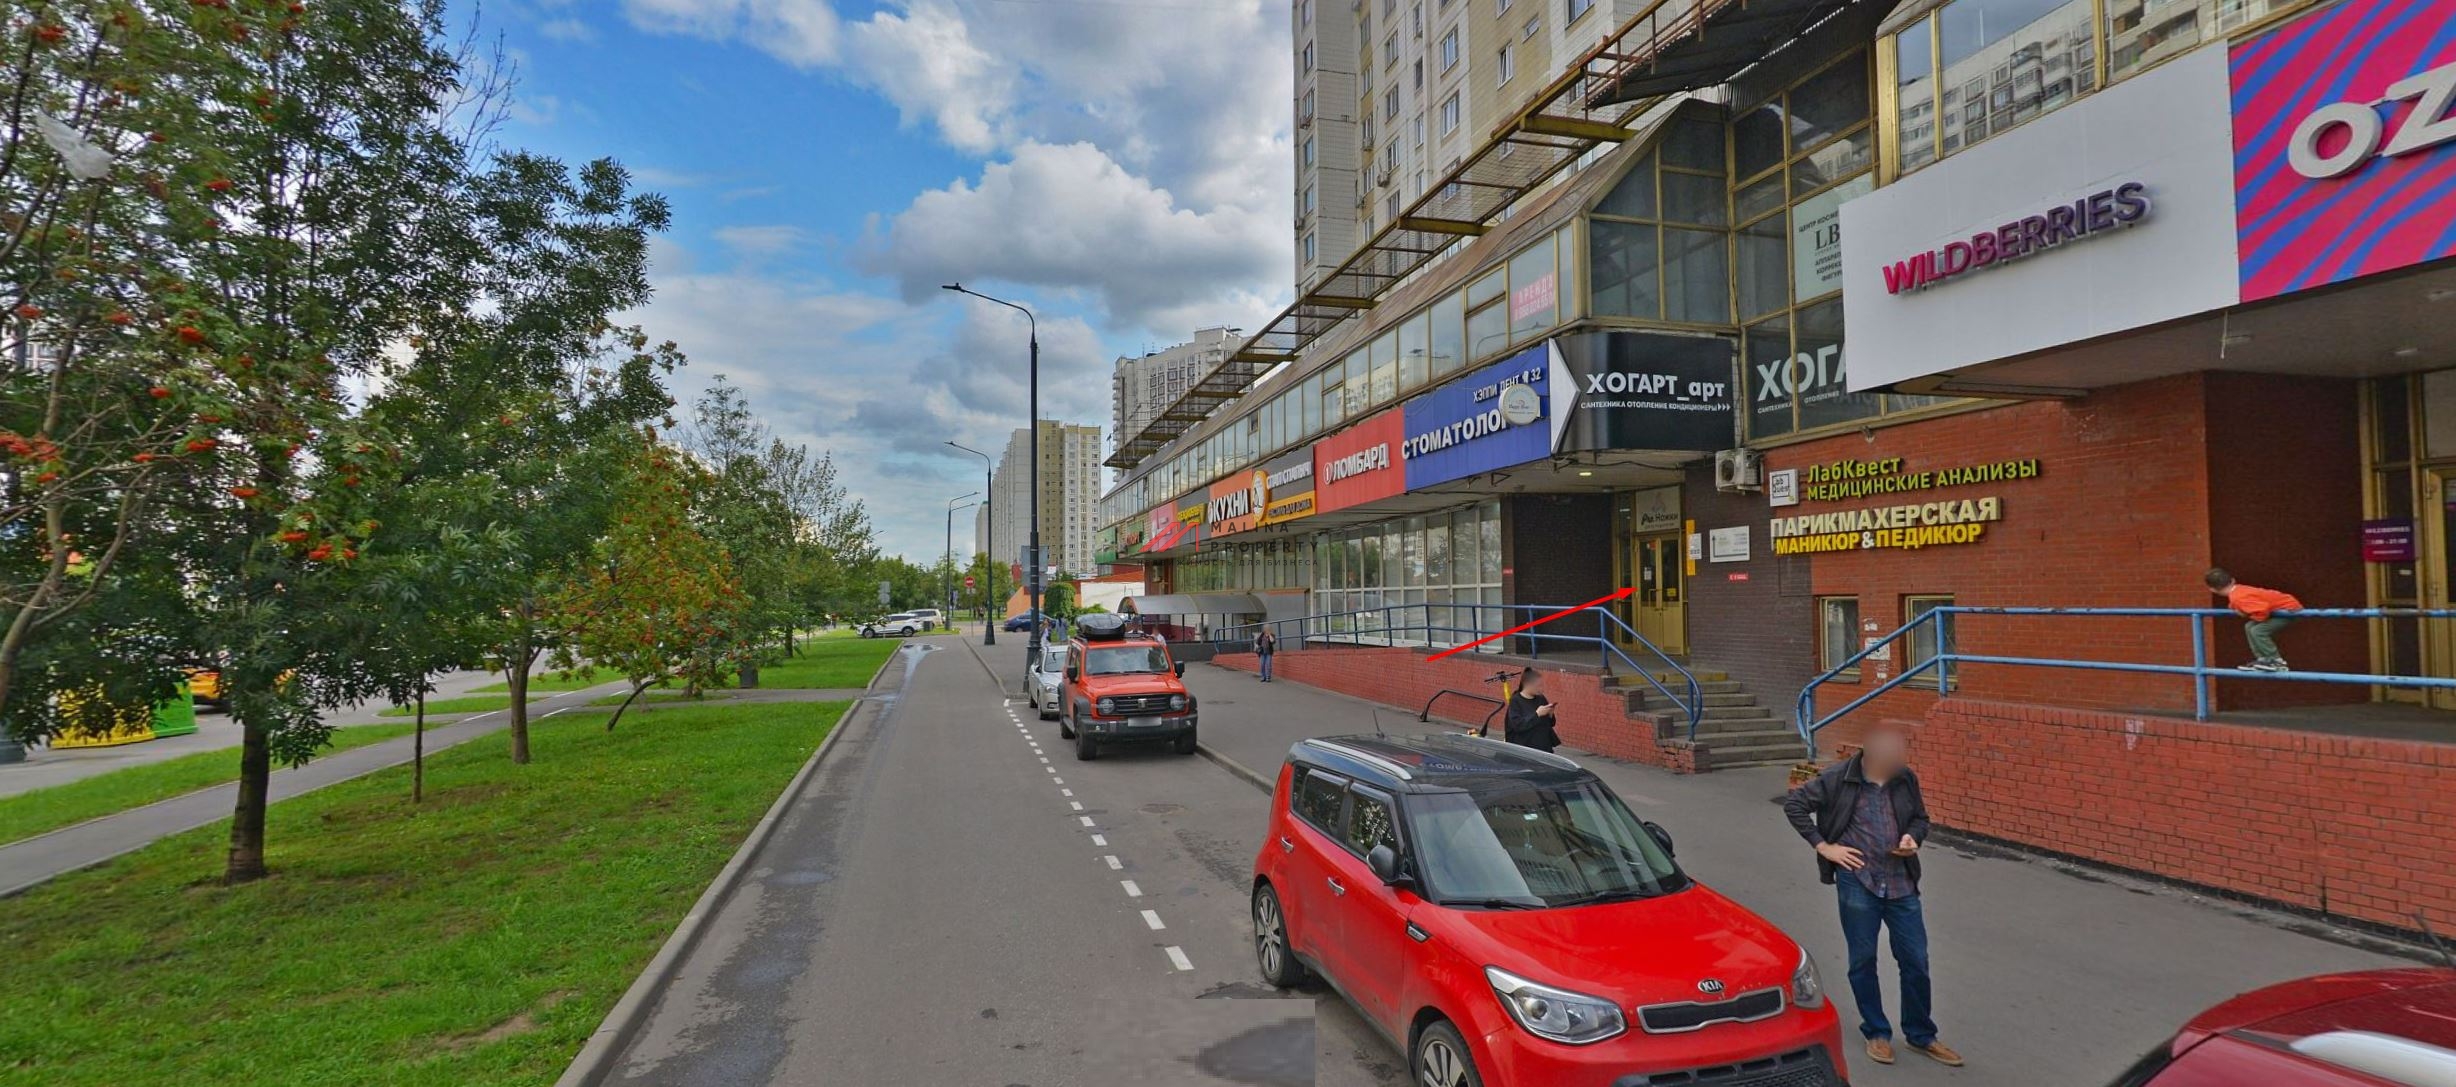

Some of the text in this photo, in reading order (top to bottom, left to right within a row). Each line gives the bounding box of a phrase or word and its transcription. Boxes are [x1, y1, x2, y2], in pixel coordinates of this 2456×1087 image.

[1799, 220, 1816, 233] ЦЕНТР
[1882, 181, 2147, 295] WILDBERRIES
[1473, 384, 1498, 403] ХЭППИ
[1531, 367, 1541, 381] 32
[1586, 372, 1725, 402] ХОГАРТ_арт
[1804, 390, 1840, 404] ОТОПЛЕНИЕ
[1581, 401, 1717, 412] САНТЕХНИКА ОТОПЛЕНИЕ КОНДИЦИОНЕРЫ
[1333, 442, 1390, 481] ЛОМБАРД
[1807, 457, 1901, 483] ЛабКвест
[1808, 459, 2038, 501] МЕДИЦИНСКИЕ АНАЛИЗЫ
[1213, 488, 1250, 523] КУХНИ
[1770, 497, 2000, 538] ПАРИКМАХЕРСКАЯ
[1702, 980, 1721, 991] KIA
